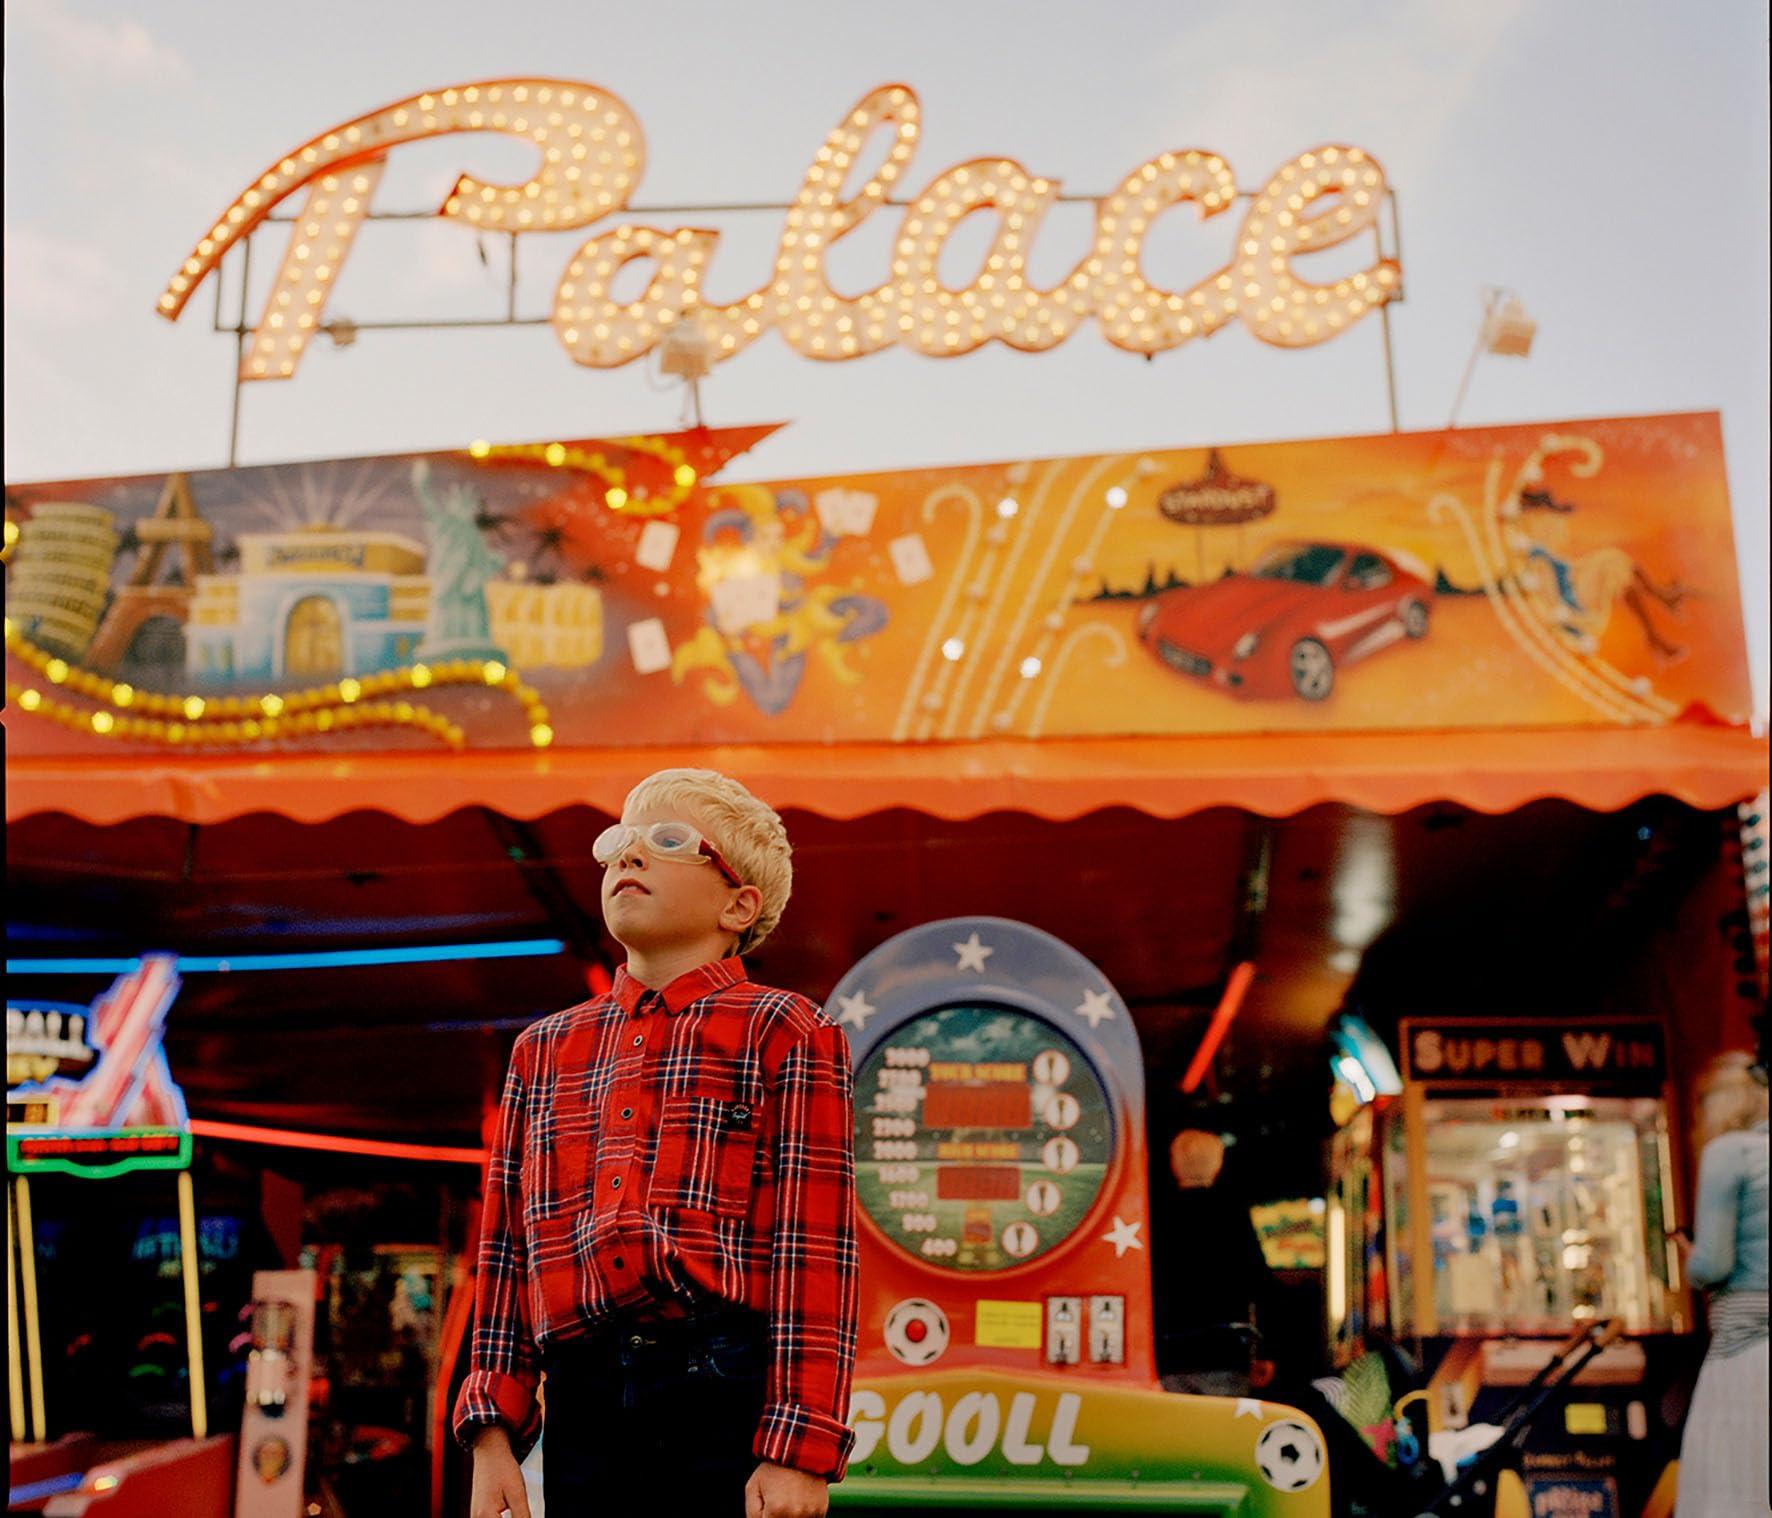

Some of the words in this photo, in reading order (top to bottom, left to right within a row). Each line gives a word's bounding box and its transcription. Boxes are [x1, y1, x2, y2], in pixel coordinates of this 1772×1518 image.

[155, 76, 1403, 382] Palace
[1414, 1029, 1545, 1074] SUPER
[1561, 1031, 1654, 1071] WIN
